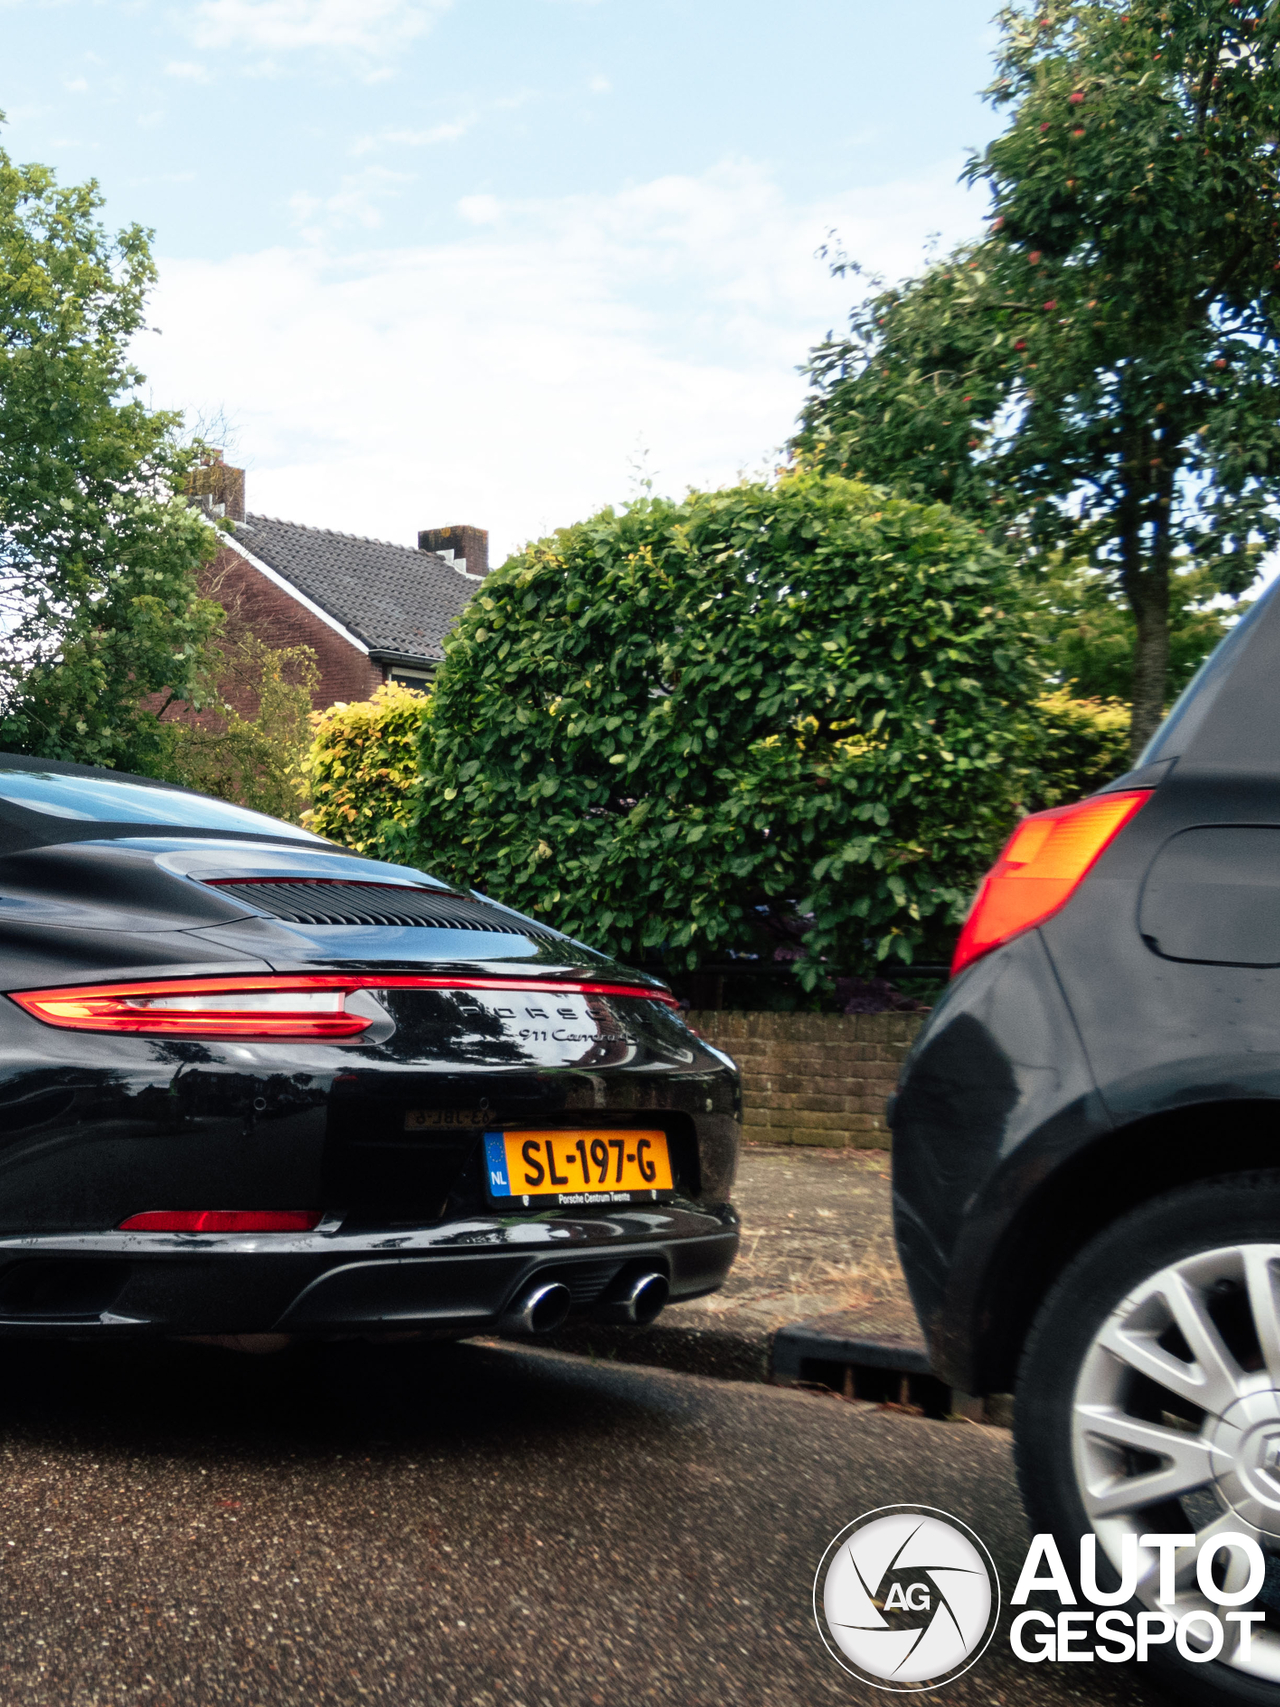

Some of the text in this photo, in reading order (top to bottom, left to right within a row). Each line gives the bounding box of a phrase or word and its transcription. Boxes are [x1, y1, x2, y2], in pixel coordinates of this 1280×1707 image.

[458, 1006, 651, 1024] PORSCHE
[518, 1028, 548, 1042] 911
[551, 1028, 616, 1043] Carrera
[521, 1138, 657, 1186] SL-197-G
[558, 1191, 631, 1205] Porsche Centrum Twente
